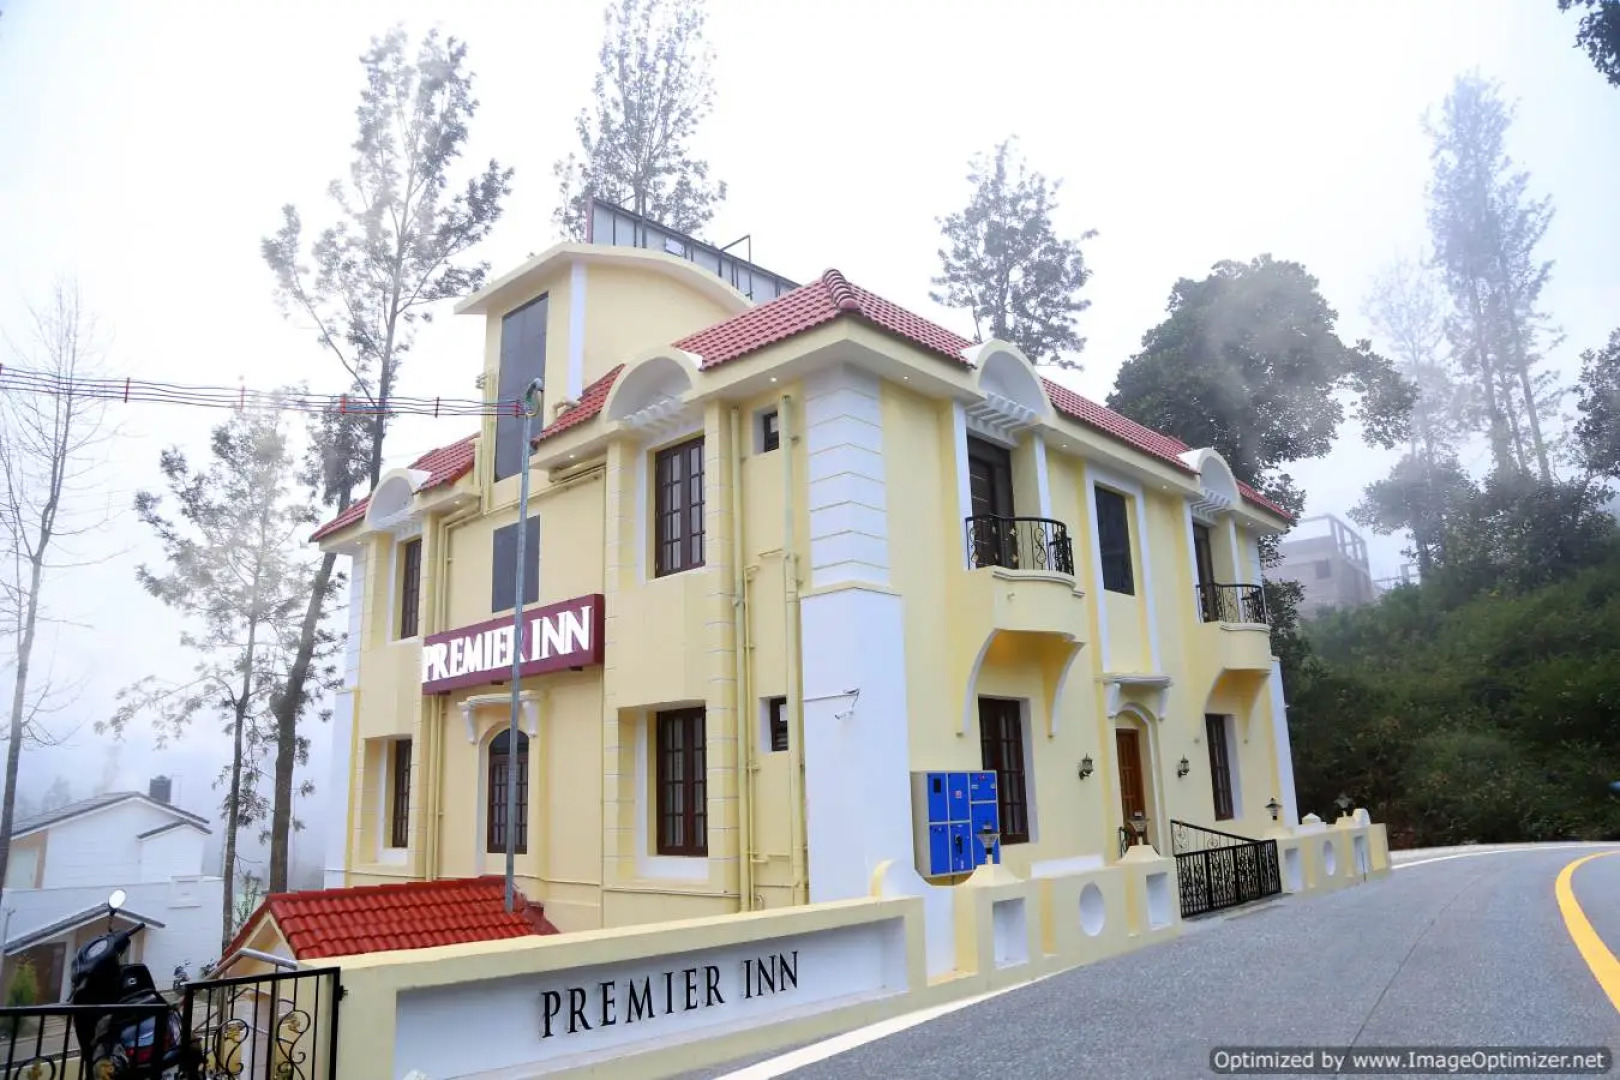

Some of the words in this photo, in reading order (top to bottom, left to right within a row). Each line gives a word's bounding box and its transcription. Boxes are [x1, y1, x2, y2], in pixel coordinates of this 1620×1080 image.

[530, 606, 592, 661] INN
[541, 965, 725, 1038] PREMIER
[744, 951, 798, 999] INN
